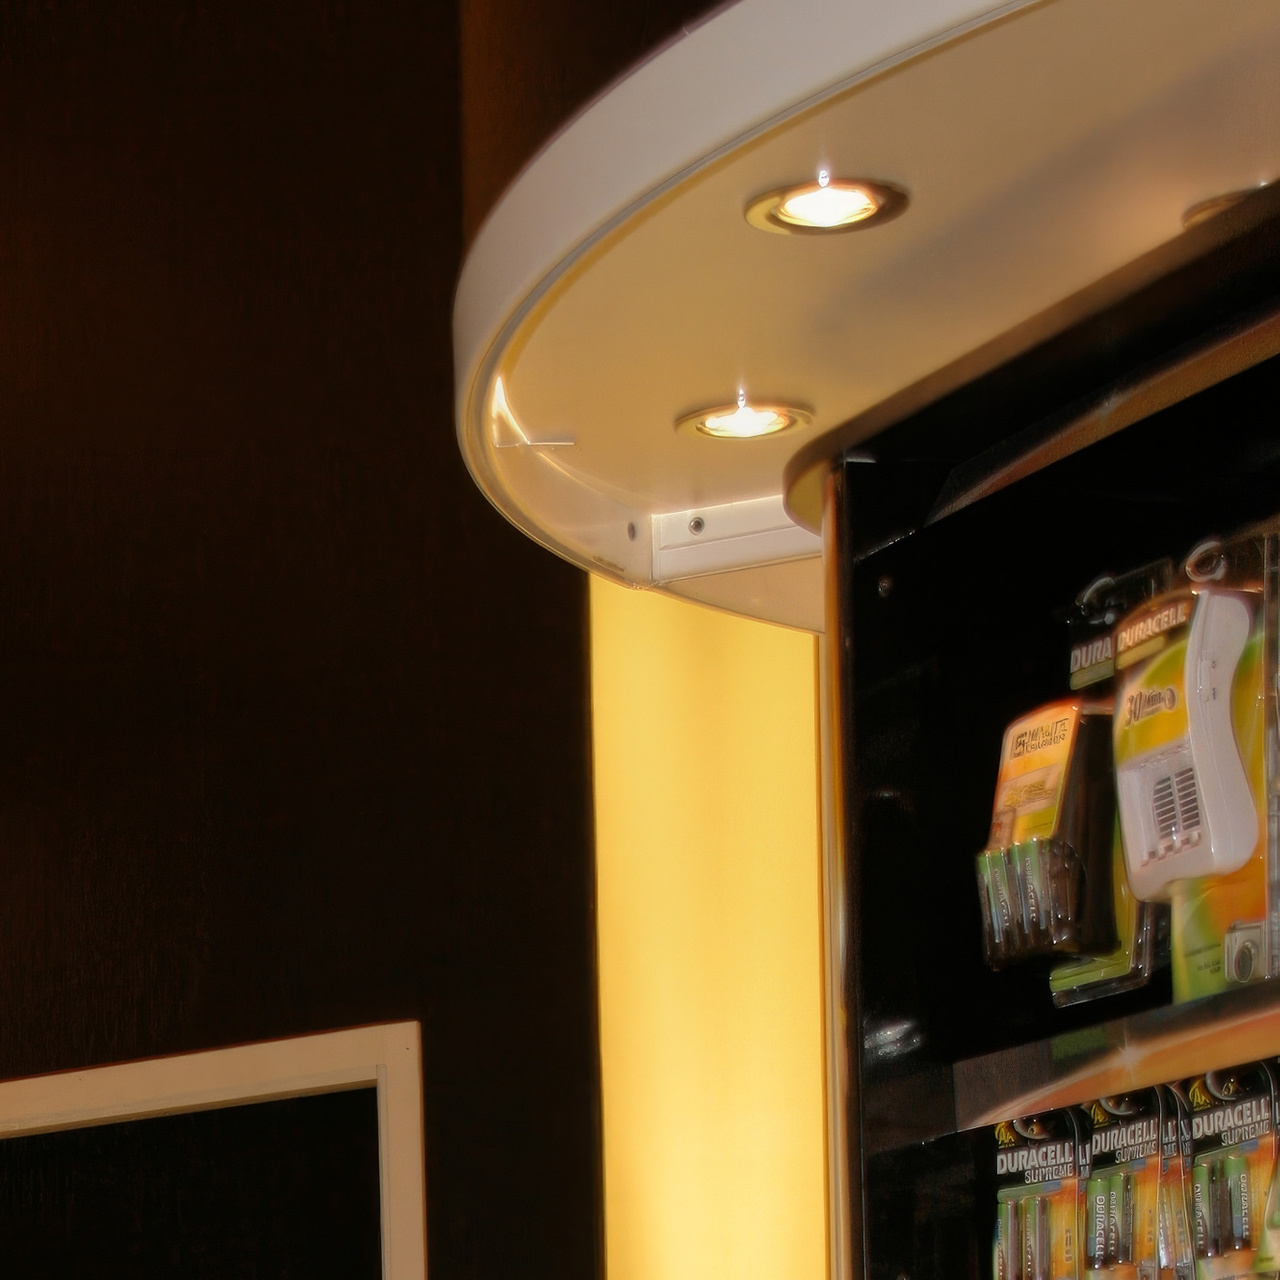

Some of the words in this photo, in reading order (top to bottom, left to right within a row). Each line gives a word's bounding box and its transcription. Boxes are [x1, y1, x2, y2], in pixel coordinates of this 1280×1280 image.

[1116, 602, 1186, 654] DURACELL
[1092, 1118, 1157, 1155] DURACELL
[1192, 1097, 1269, 1139] DURACELL
[996, 1142, 1074, 1175] DURACELL
[1024, 1163, 1073, 1184] SUPREME
